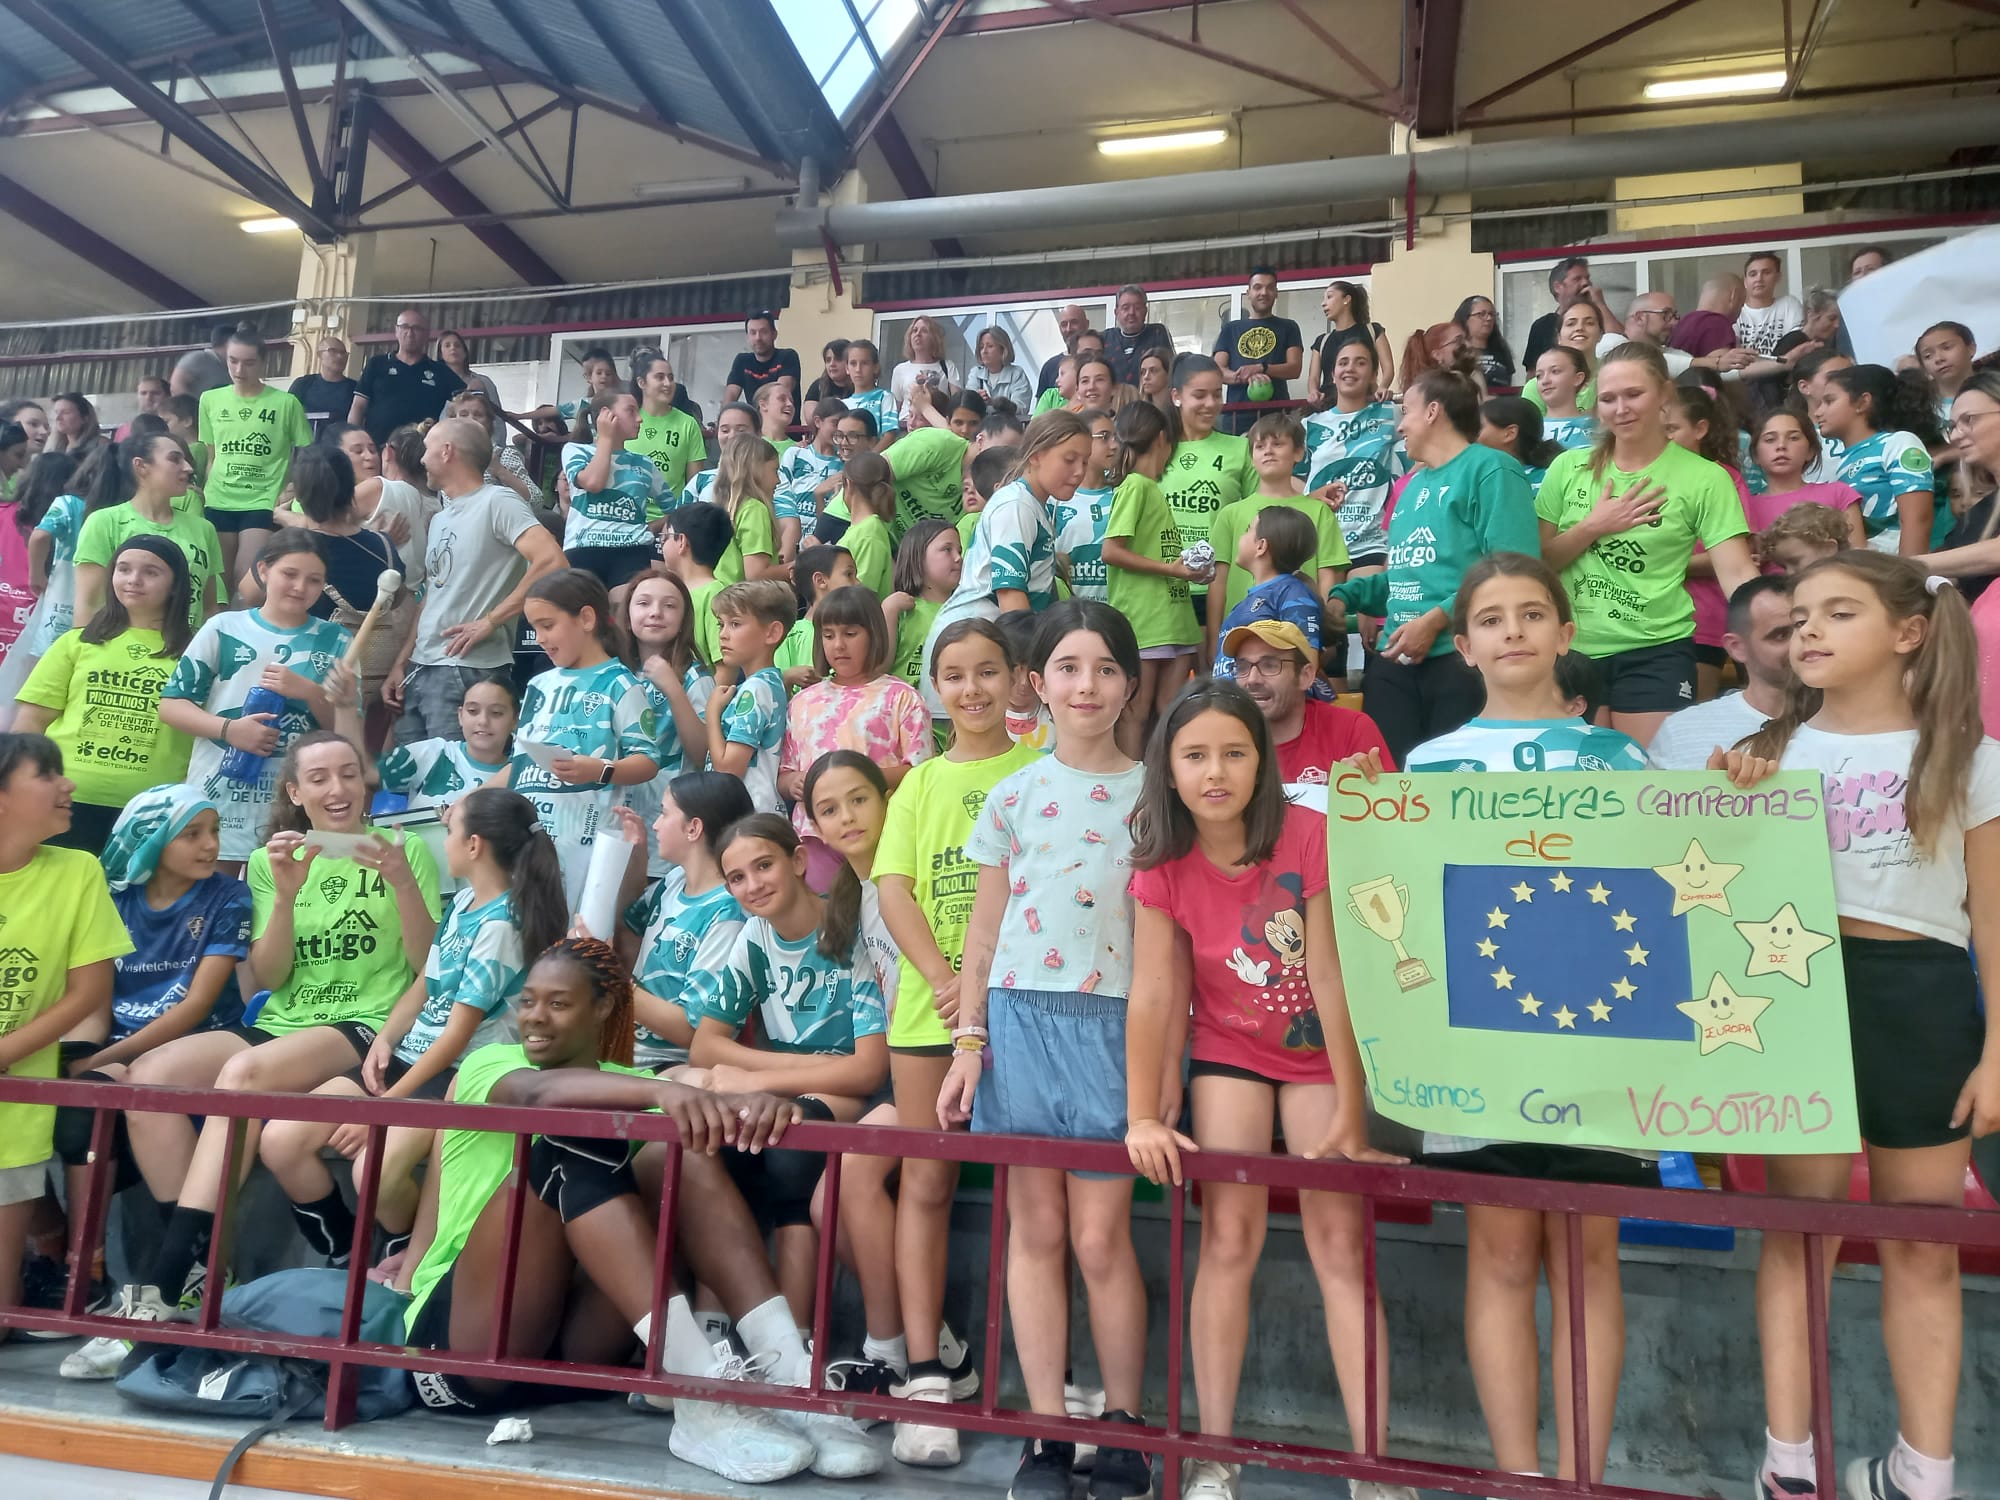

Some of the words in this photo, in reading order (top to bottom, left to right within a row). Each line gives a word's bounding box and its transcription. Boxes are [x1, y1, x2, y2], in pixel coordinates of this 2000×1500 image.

[258, 409, 276, 424] 44
[665, 430, 680, 447] 13
[1337, 421, 1360, 442] 39
[1550, 425, 1576, 442] 17
[222, 438, 271, 456] atticgo
[820, 466, 829, 478] 4
[1212, 455, 1223, 471] 4
[1090, 503, 1103, 522] 9
[274, 644, 292, 665] 2
[88, 691, 146, 711] PIKOLINOS
[549, 685, 577, 714] 10
[97, 713, 154, 727] COMUNITAT
[100, 720, 113, 728] DE
[115, 722, 160, 735] L'ESPORT
[97, 746, 149, 763] elche
[231, 791, 250, 803] DE
[1336, 773, 1430, 822] Sois
[1451, 785, 1625, 821] nuestras
[1505, 830, 1574, 861] de
[355, 868, 386, 898] 14
[1767, 953, 1788, 964] DE
[0, 966, 38, 989] go
[779, 965, 817, 1014] 22
[1362, 1037, 1486, 1114] Estamos
[1520, 1088, 1582, 1127] Con
[1627, 1083, 1834, 1138] VOSOTRAS
